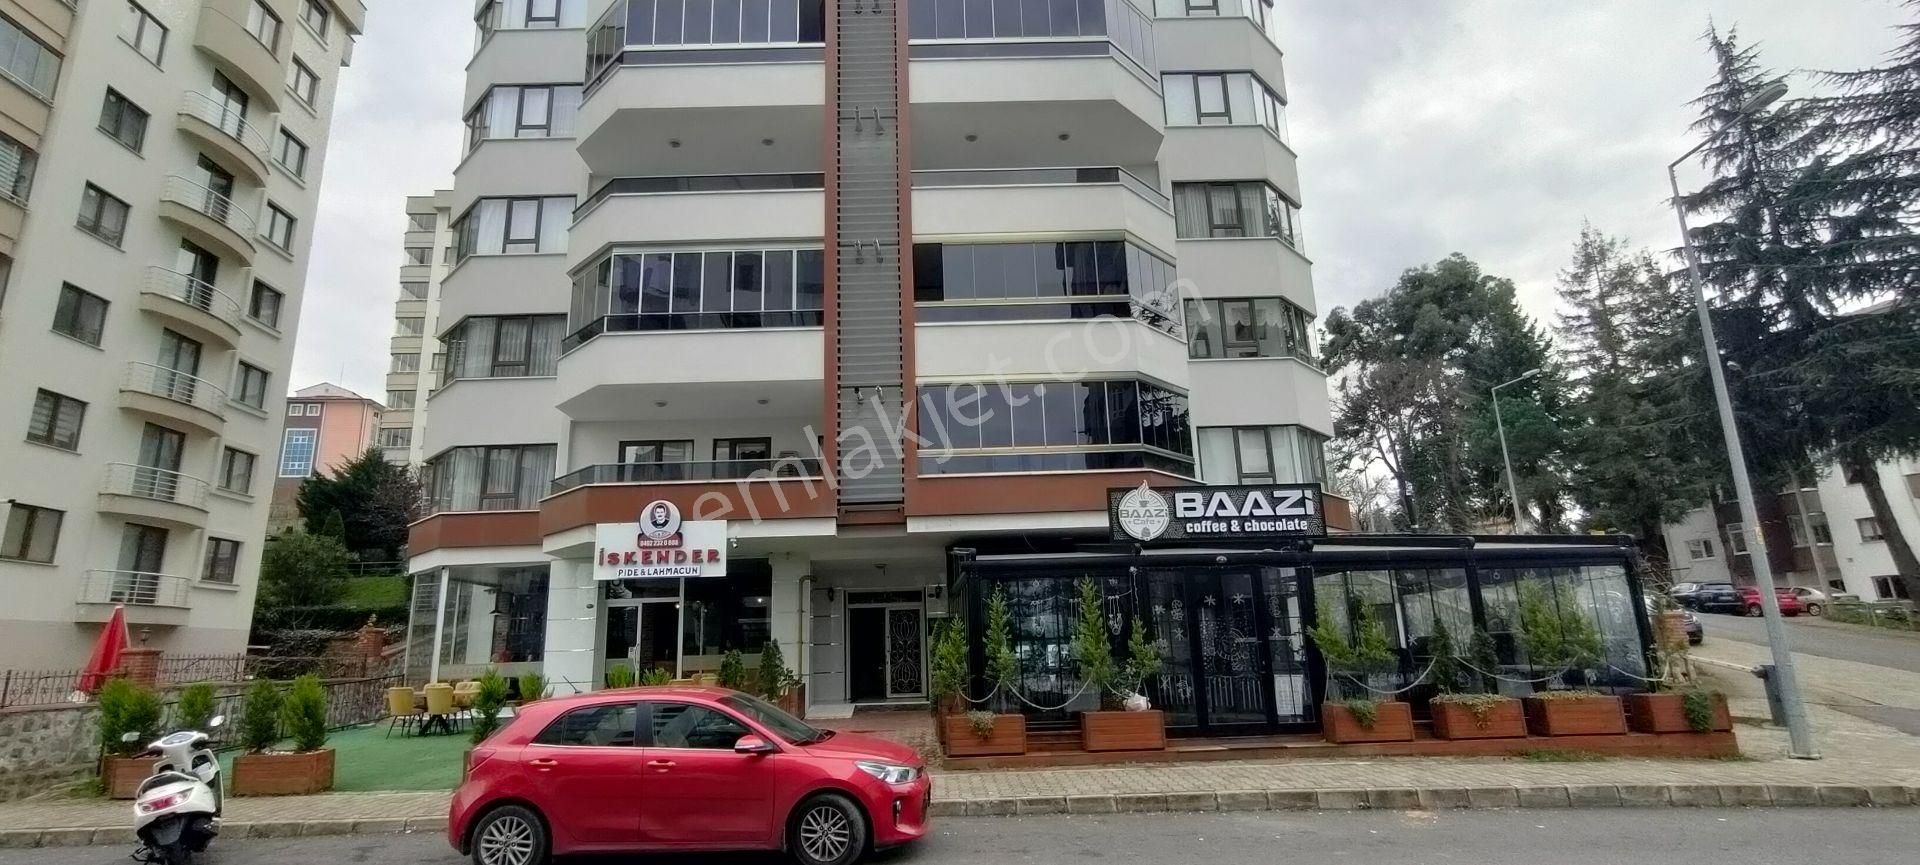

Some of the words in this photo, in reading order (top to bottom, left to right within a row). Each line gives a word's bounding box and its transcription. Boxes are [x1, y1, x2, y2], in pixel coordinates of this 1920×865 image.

[1186, 520, 1227, 533] coffee
[1231, 520, 1240, 532] &
[1244, 518, 1308, 532] chocolate
[598, 547, 720, 566] İSKENDER
